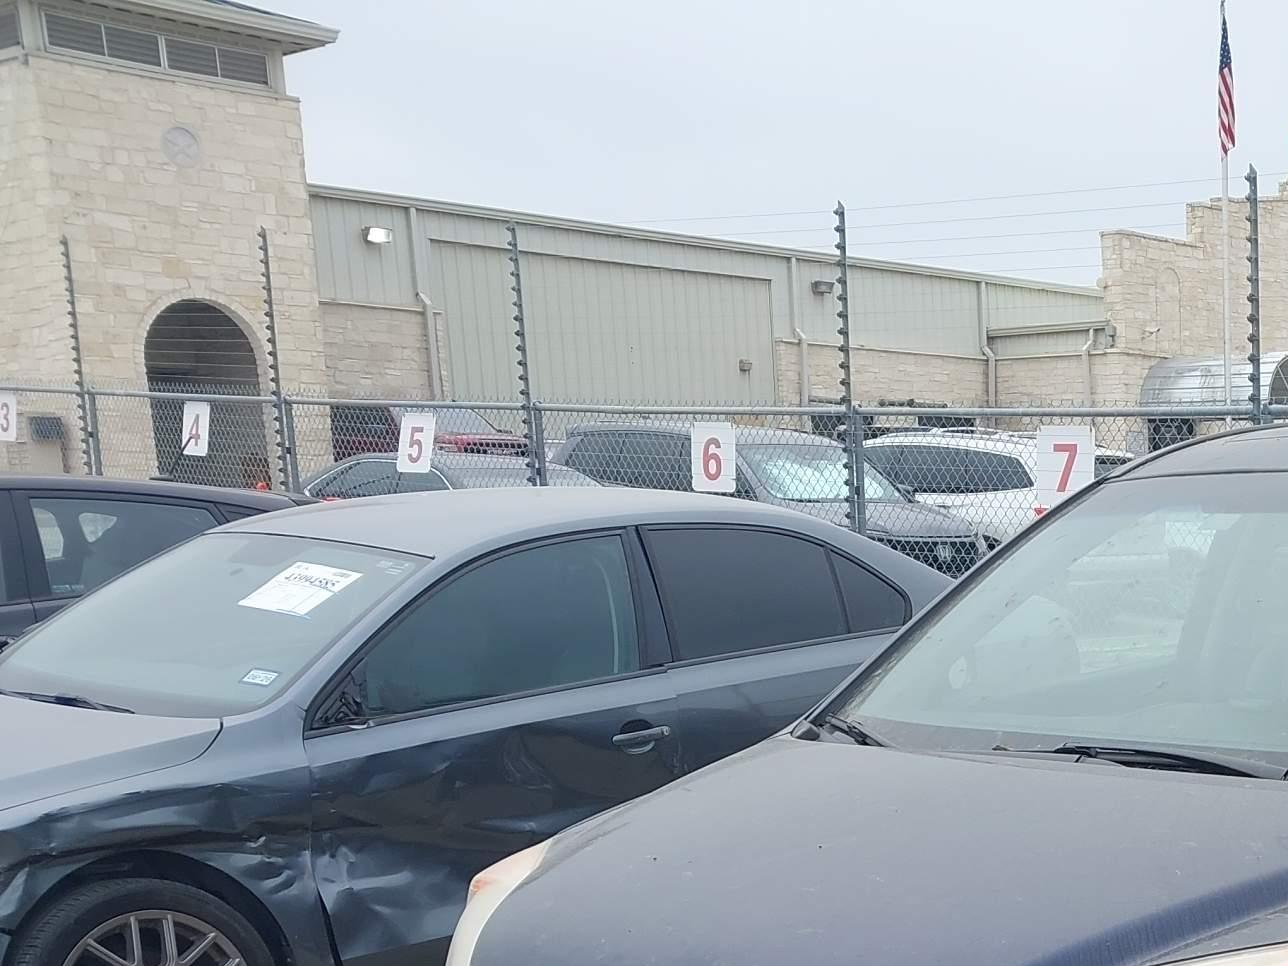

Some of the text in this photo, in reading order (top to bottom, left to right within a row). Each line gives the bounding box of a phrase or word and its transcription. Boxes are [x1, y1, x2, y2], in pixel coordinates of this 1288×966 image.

[0, 402, 10, 433] 3
[188, 413, 201, 447] 4
[408, 426, 424, 464] 5
[702, 437, 723, 481] 6
[1053, 443, 1078, 493] 7
